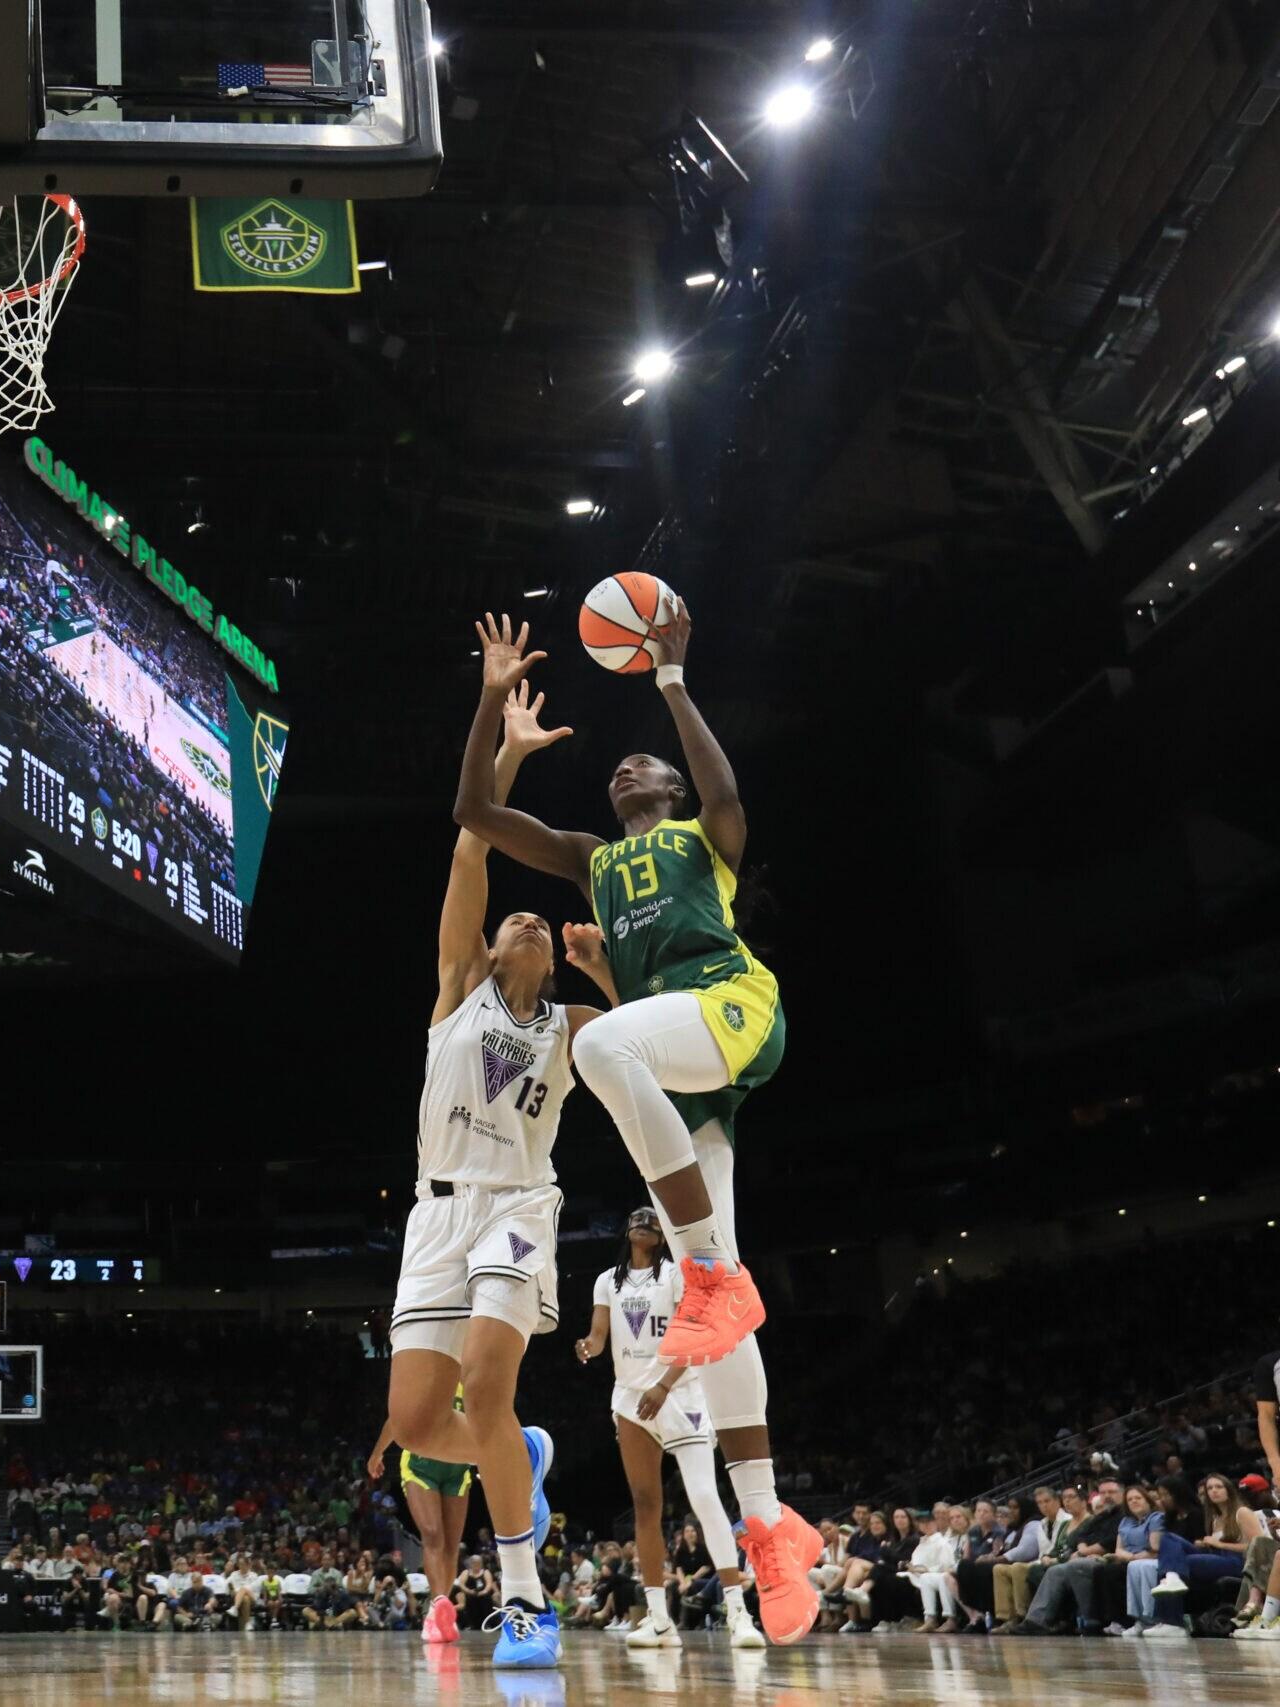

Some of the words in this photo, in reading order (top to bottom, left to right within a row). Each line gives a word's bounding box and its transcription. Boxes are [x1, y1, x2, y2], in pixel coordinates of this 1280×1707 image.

[229, 233, 281, 272] SEATTLE
[286, 235, 319, 270] STORM
[24, 436, 130, 557] CLIMATE
[131, 534, 214, 634] PLEDGE
[213, 614, 279, 693] ARENA
[67, 791, 85, 823] 25
[112, 819, 141, 861] 5:20
[164, 857, 178, 887] 23
[595, 832, 688, 888] SEATTLE
[12, 860, 55, 895] SYMETRA
[615, 852, 659, 902] 13
[481, 1030, 537, 1066] VALKYRIES
[514, 1075, 549, 1119] 13
[472, 1125, 516, 1147] PERMANENTE
[474, 1117, 496, 1131] KAISER
[50, 1259, 77, 1281] 23
[101, 1268, 110, 1281] 2
[133, 1268, 142, 1281] 4
[650, 1315, 668, 1337] 15
